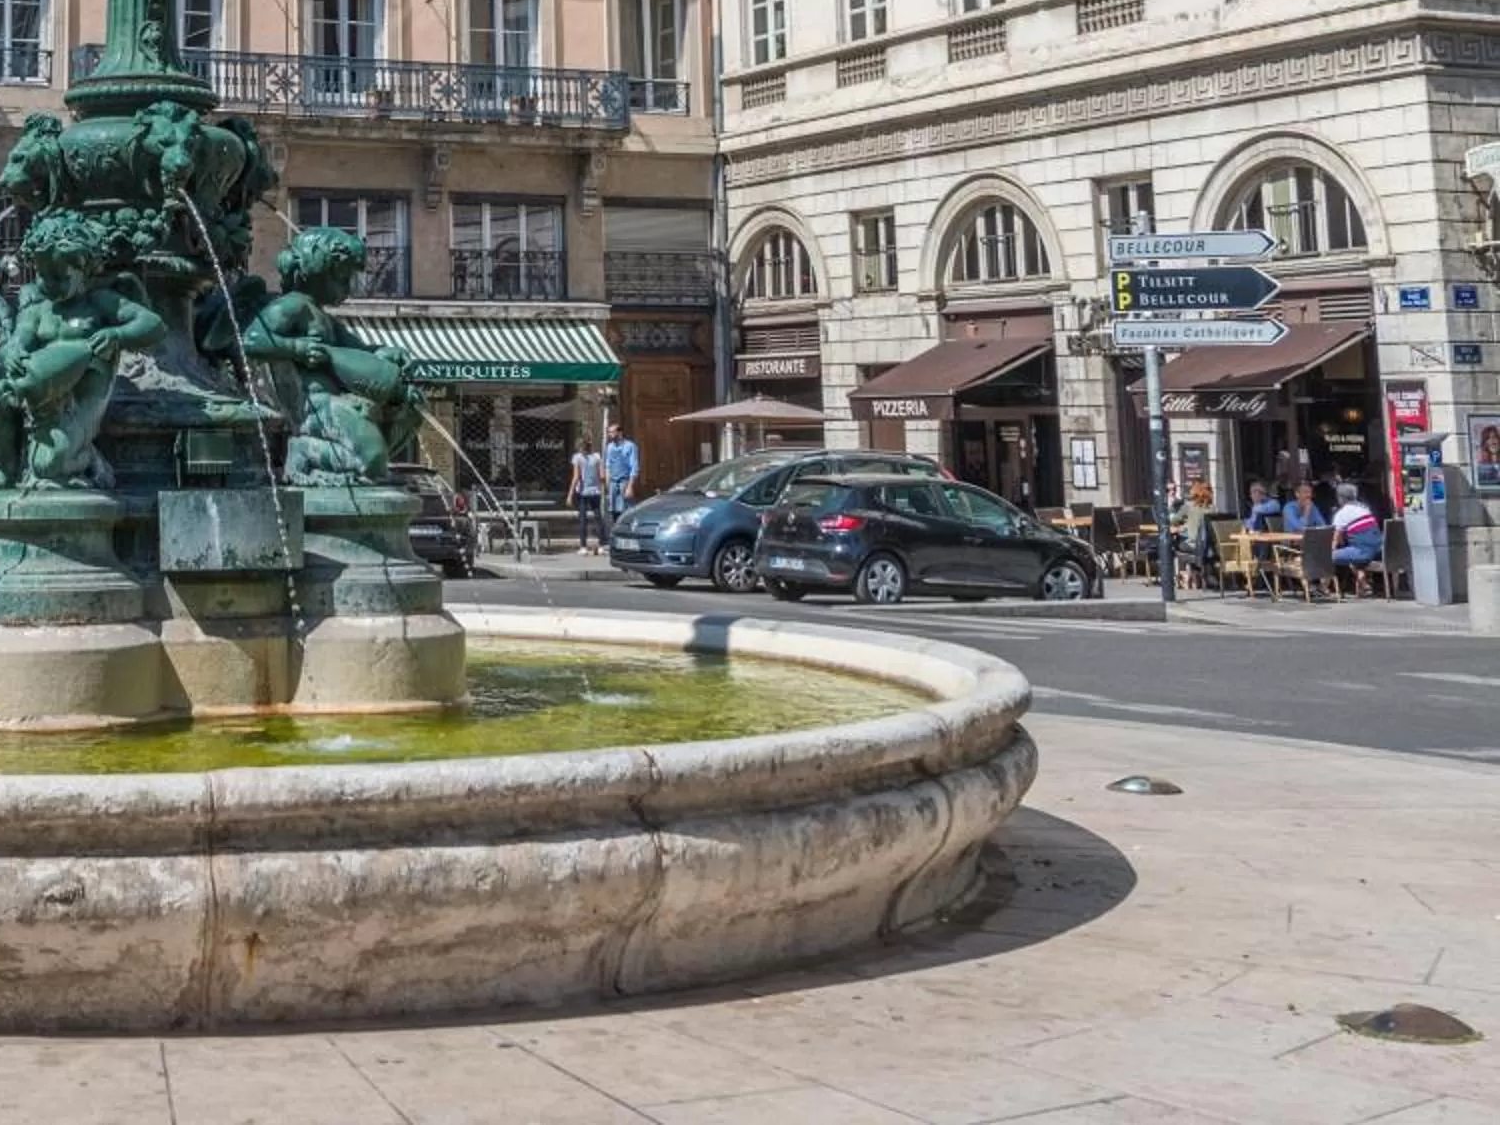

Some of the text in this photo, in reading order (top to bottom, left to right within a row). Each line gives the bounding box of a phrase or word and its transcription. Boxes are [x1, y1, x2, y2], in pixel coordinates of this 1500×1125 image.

[1117, 240, 1206, 255] BELLECOUR
[1117, 273, 1130, 290] P
[1119, 292, 1229, 309] P BELLECOUR
[1183, 326, 1264, 339] Catholiques
[746, 360, 806, 376] RISTORANTE
[872, 400, 928, 416] PIZZERIA
[1204, 393, 1269, 417] Italy
